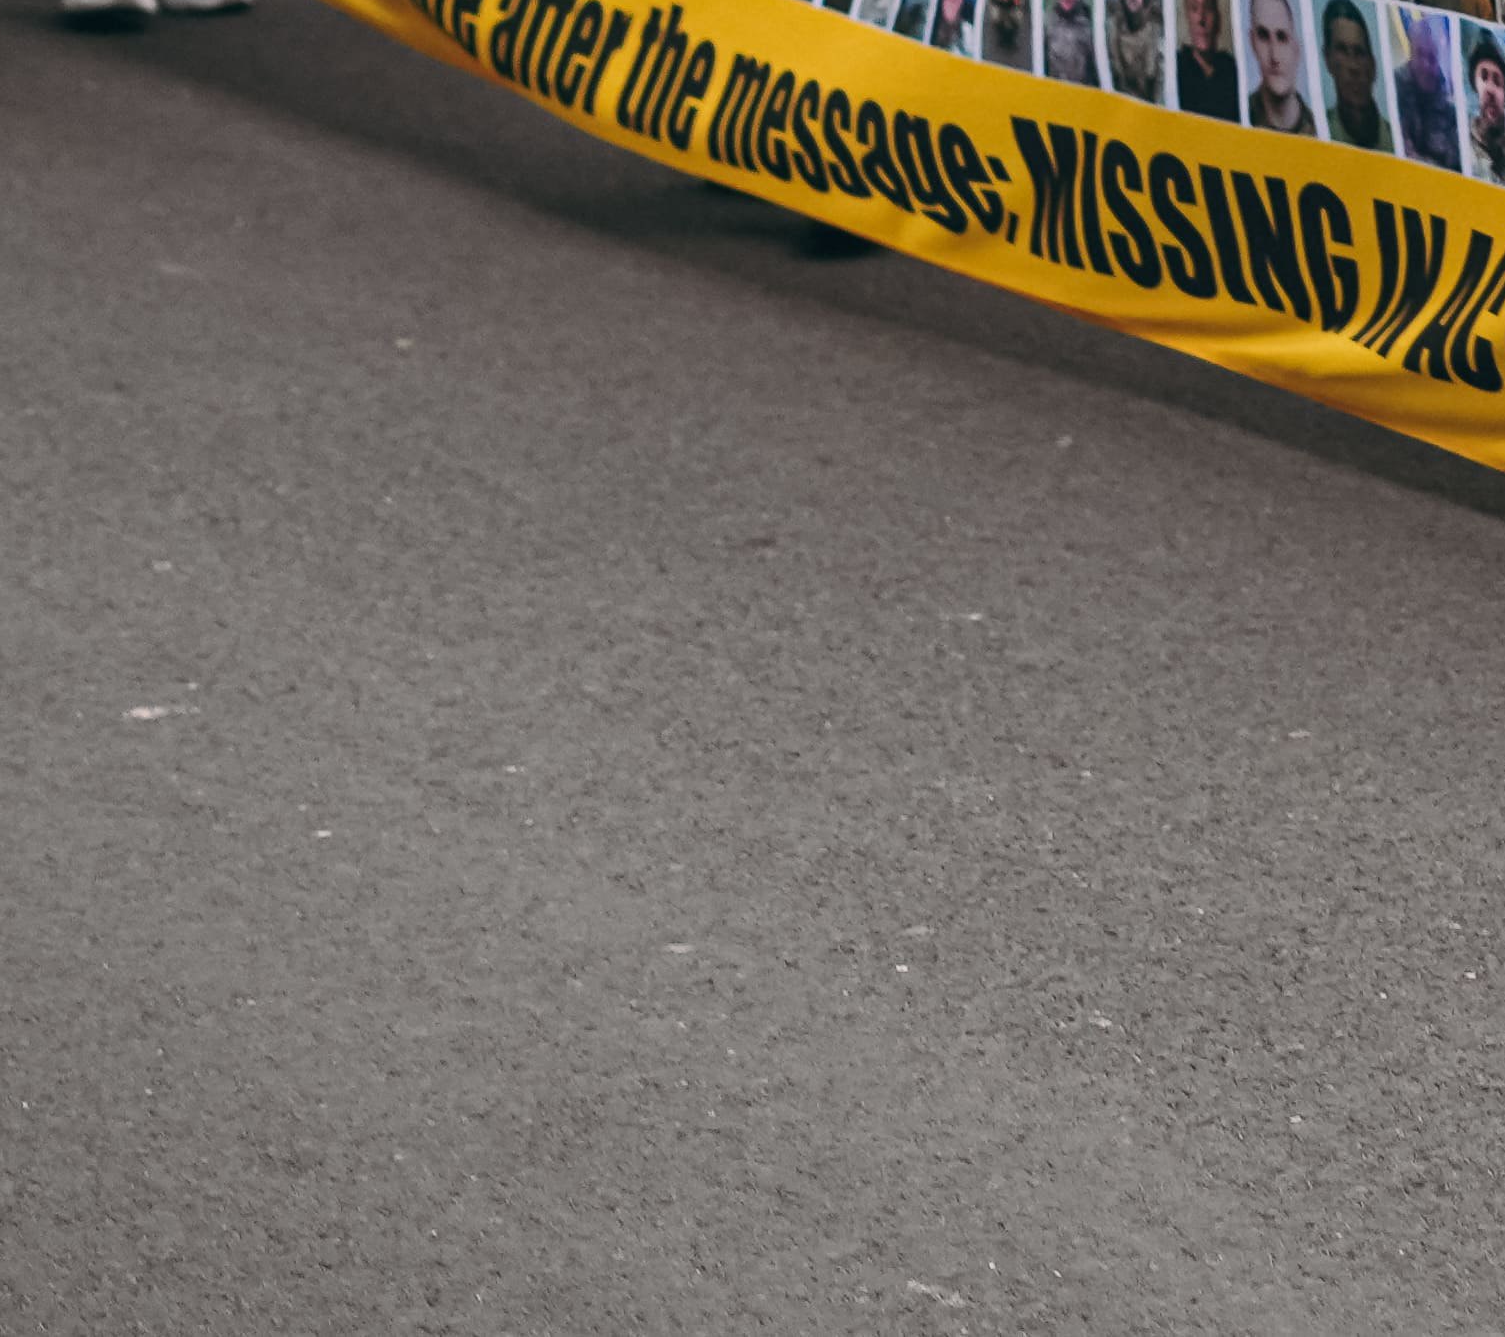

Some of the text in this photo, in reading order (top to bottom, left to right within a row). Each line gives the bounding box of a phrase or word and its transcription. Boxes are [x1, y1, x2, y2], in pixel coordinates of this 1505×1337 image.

[615, 2, 716, 153] the
[707, 52, 1020, 245] message:
[1010, 114, 1360, 335] MISSING
[1352, 198, 1448, 359] IN
